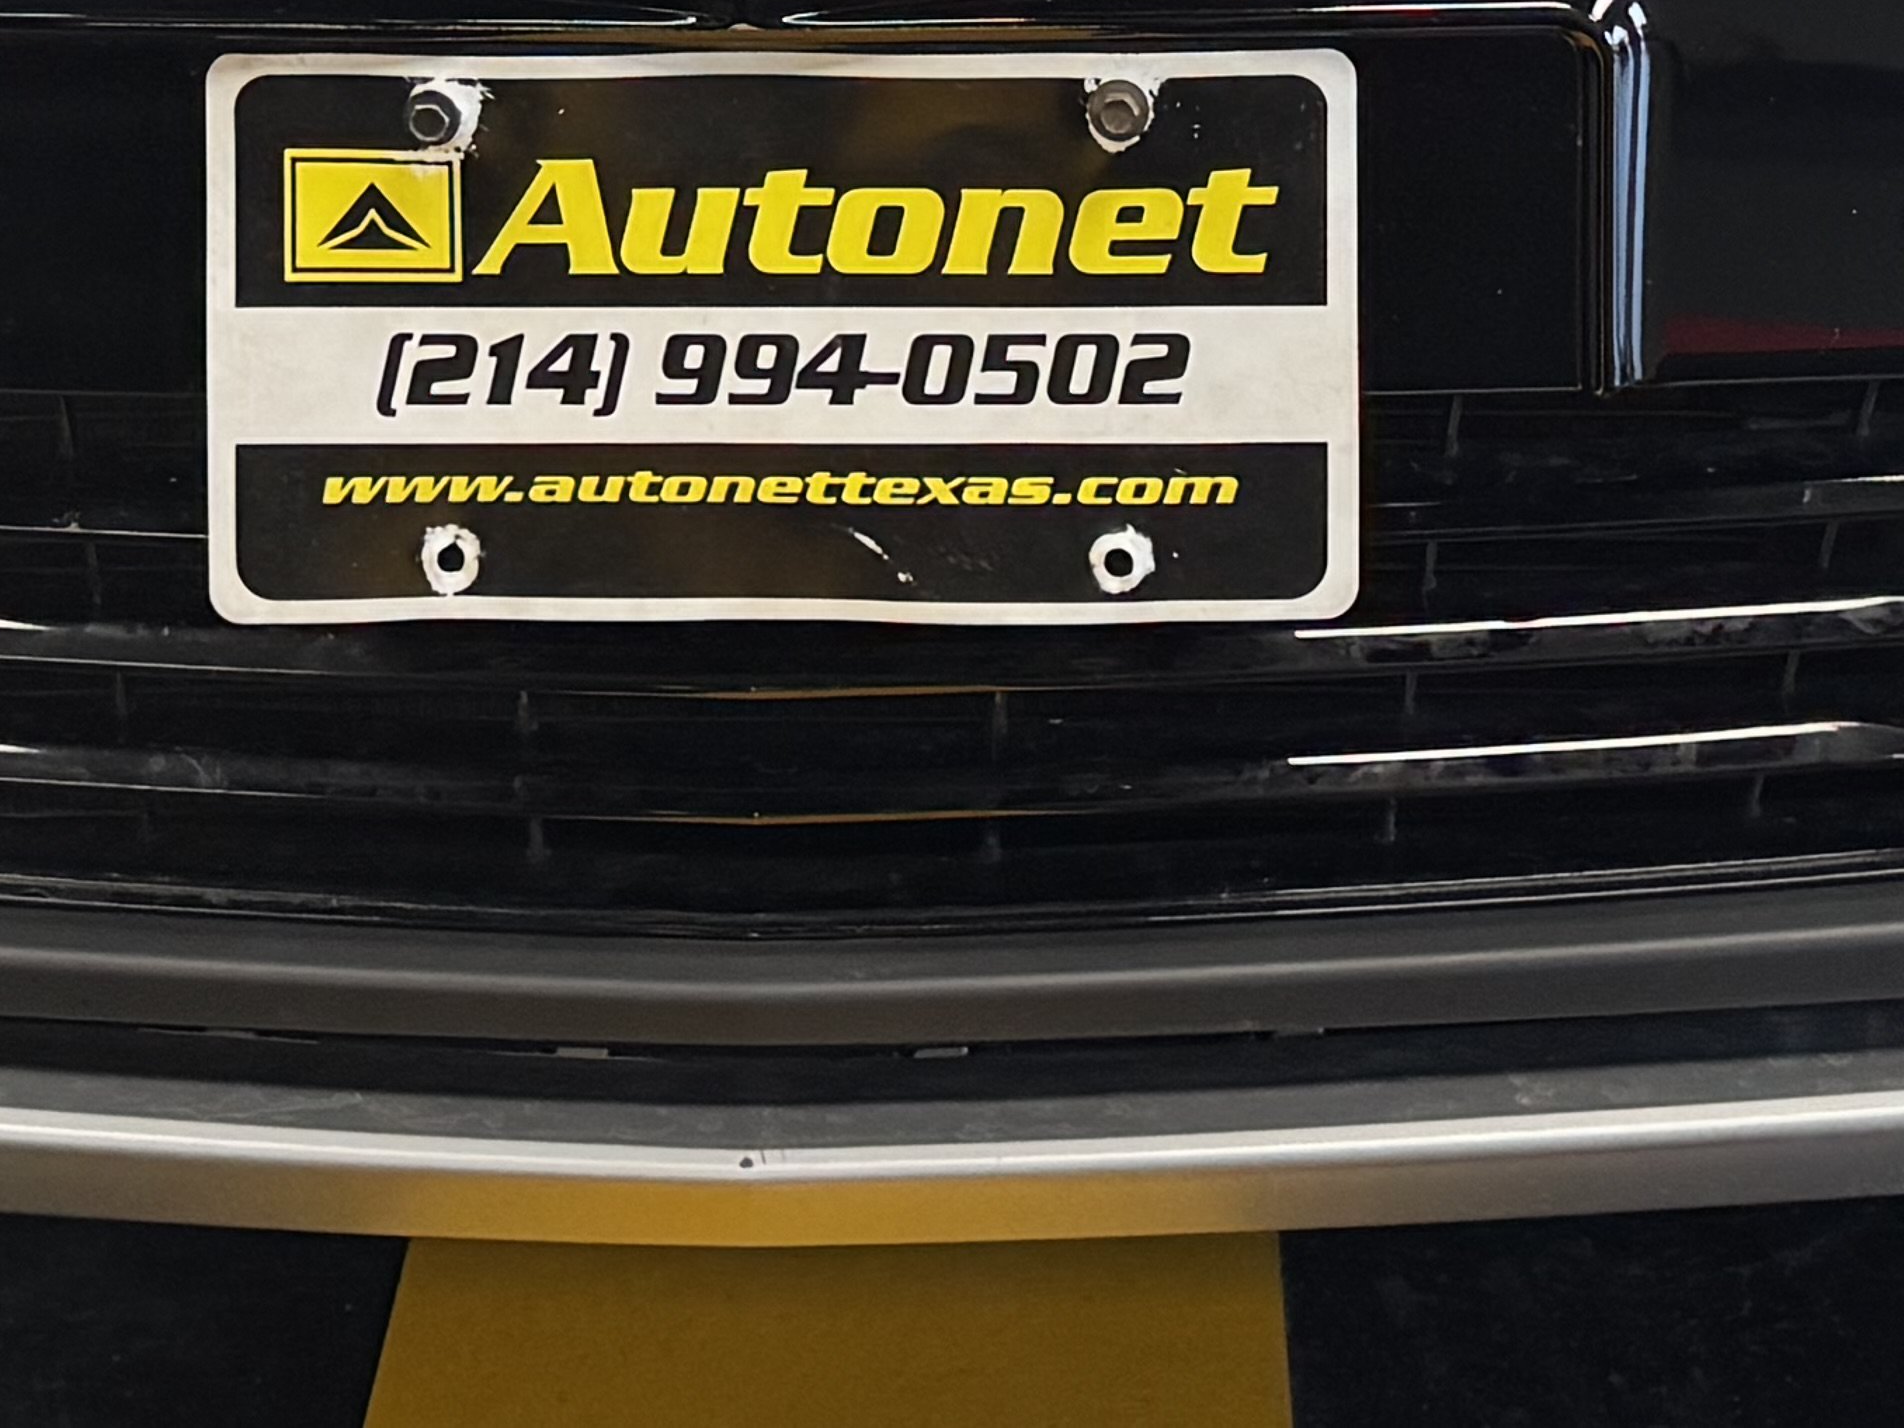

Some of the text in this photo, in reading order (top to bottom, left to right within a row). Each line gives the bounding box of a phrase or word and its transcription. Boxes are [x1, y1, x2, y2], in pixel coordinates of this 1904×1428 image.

[472, 157, 1280, 276] Autonet
[376, 332, 1192, 418] (214) 994-0502
[322, 469, 1239, 506] www.autonettexas.com
